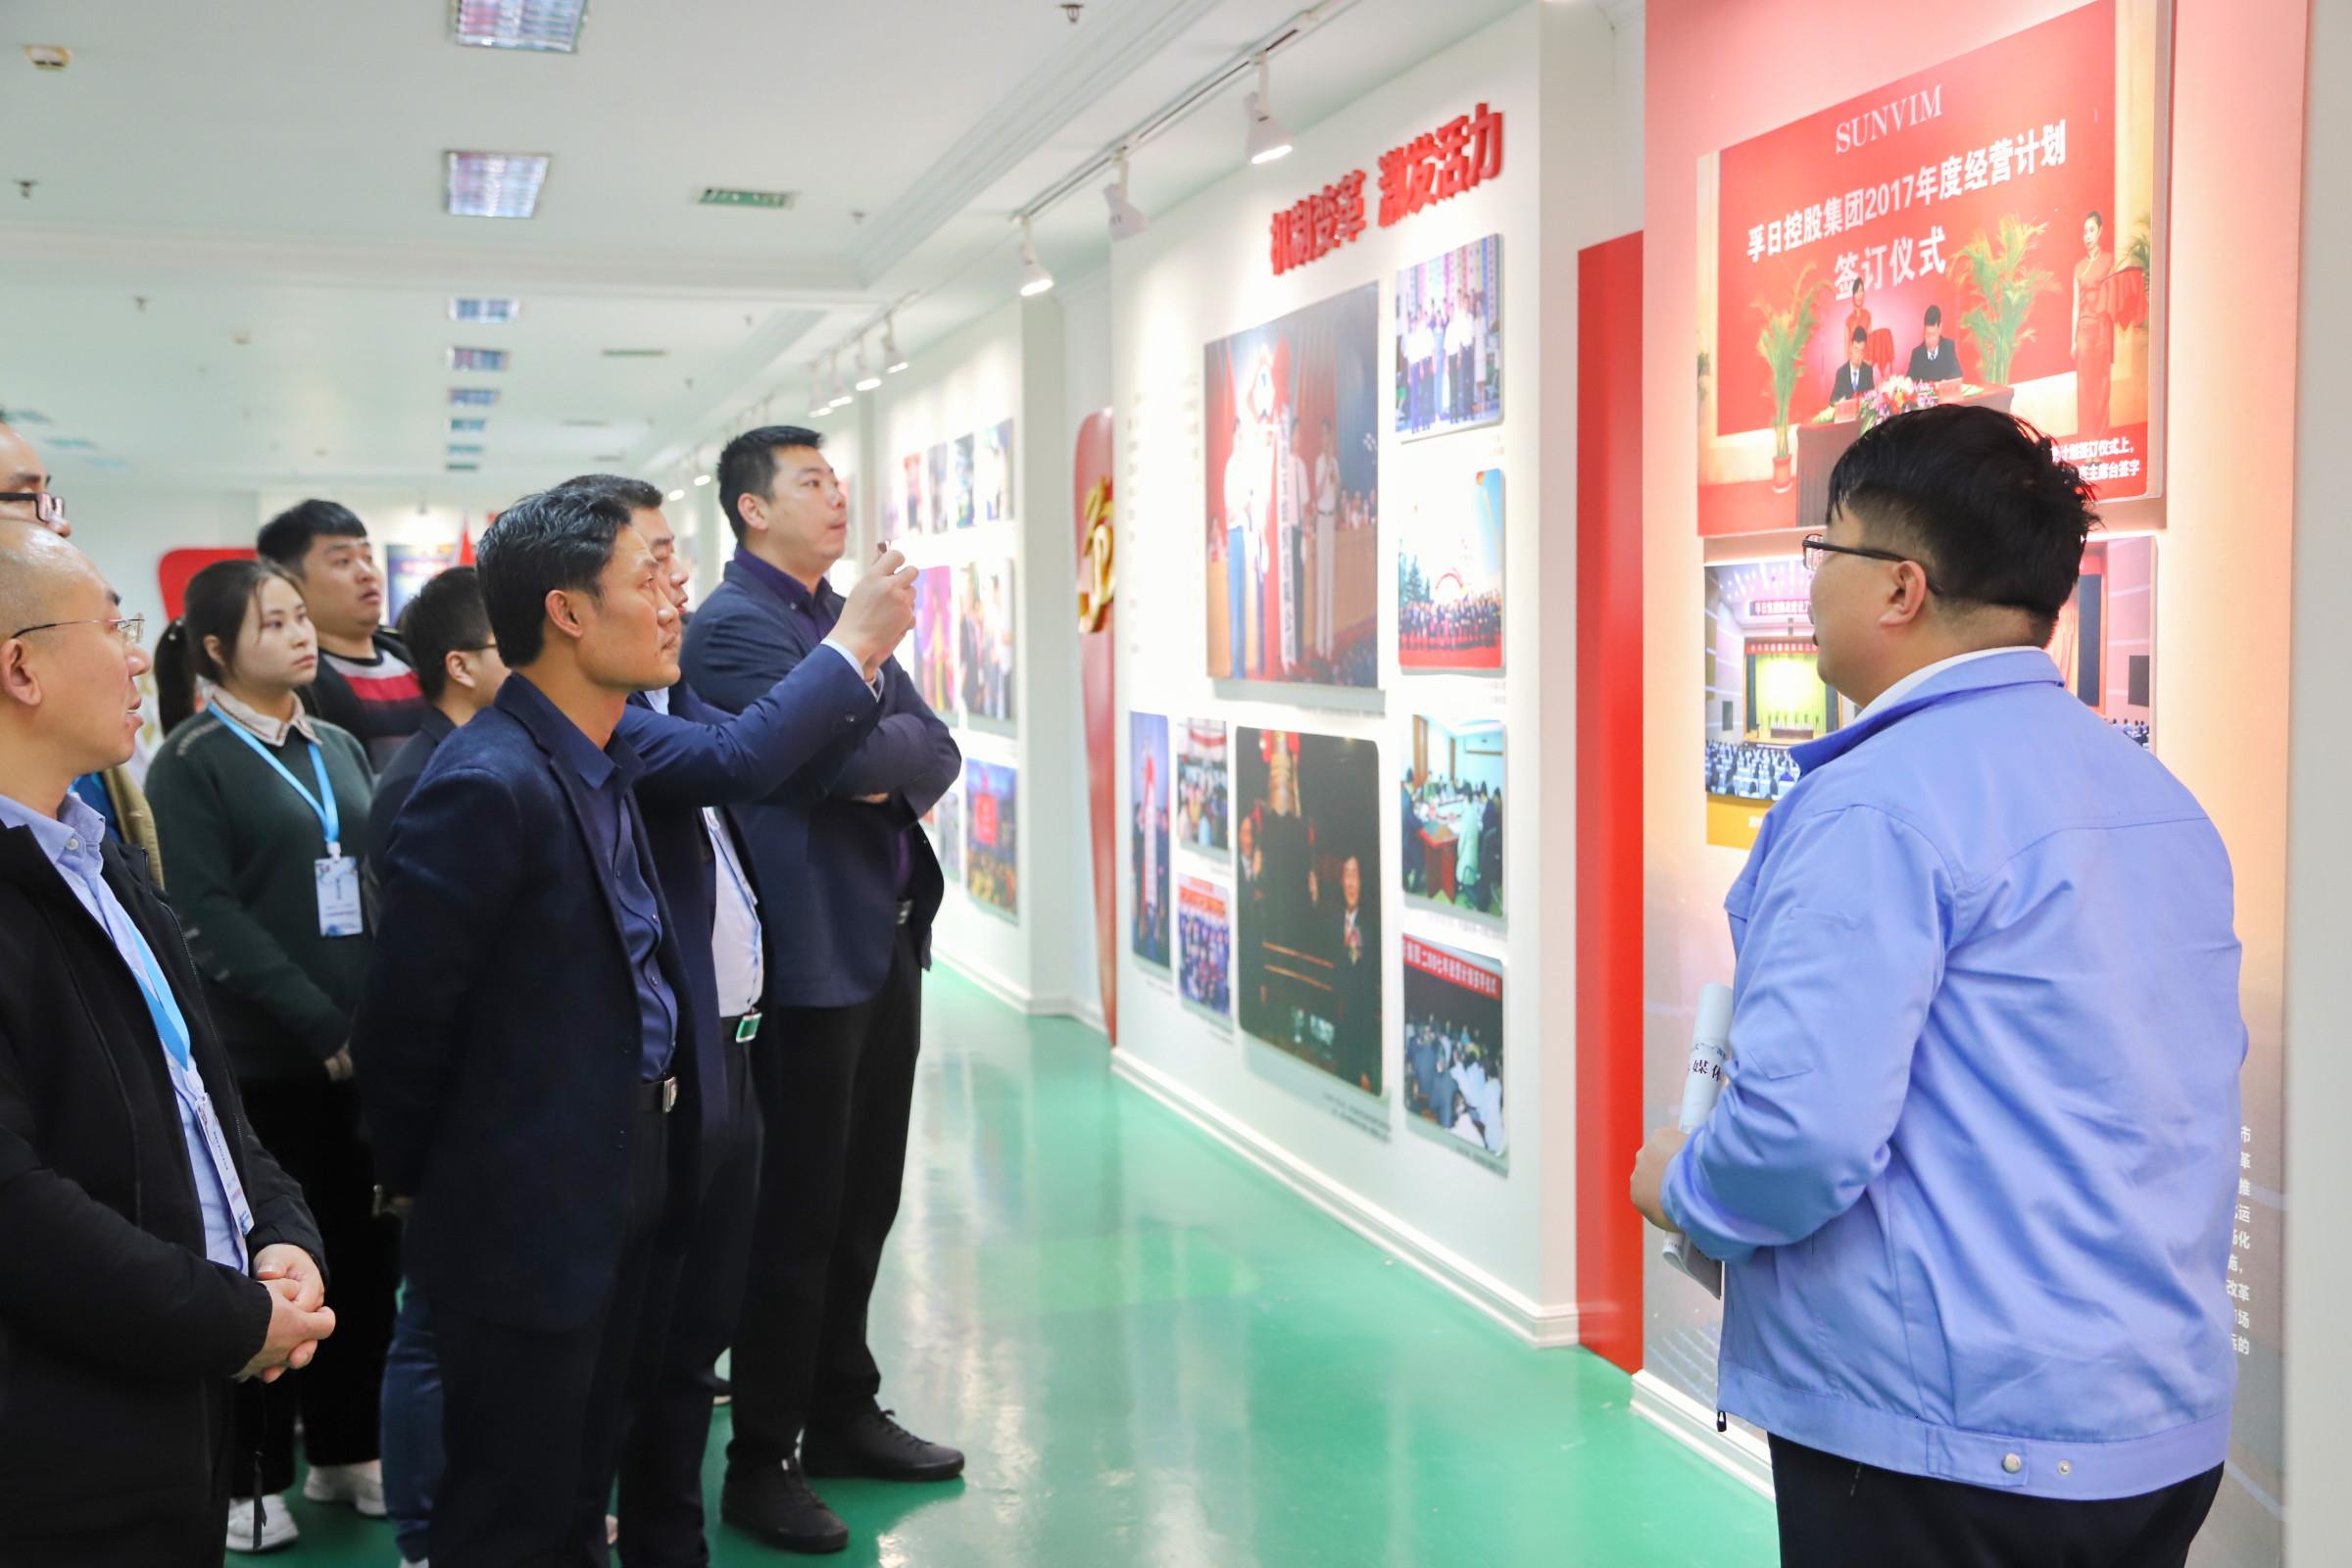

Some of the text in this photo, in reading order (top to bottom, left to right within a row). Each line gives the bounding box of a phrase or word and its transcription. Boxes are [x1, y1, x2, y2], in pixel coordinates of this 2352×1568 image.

[1836, 84, 1943, 154] SUNVIM
[1377, 102, 1503, 227] 激发活力
[1746, 119, 2067, 263] 孚日控股集团2017年度经营计划
[1834, 225, 1947, 301] 签订仪式
[2234, 1308, 2249, 1329] 场
